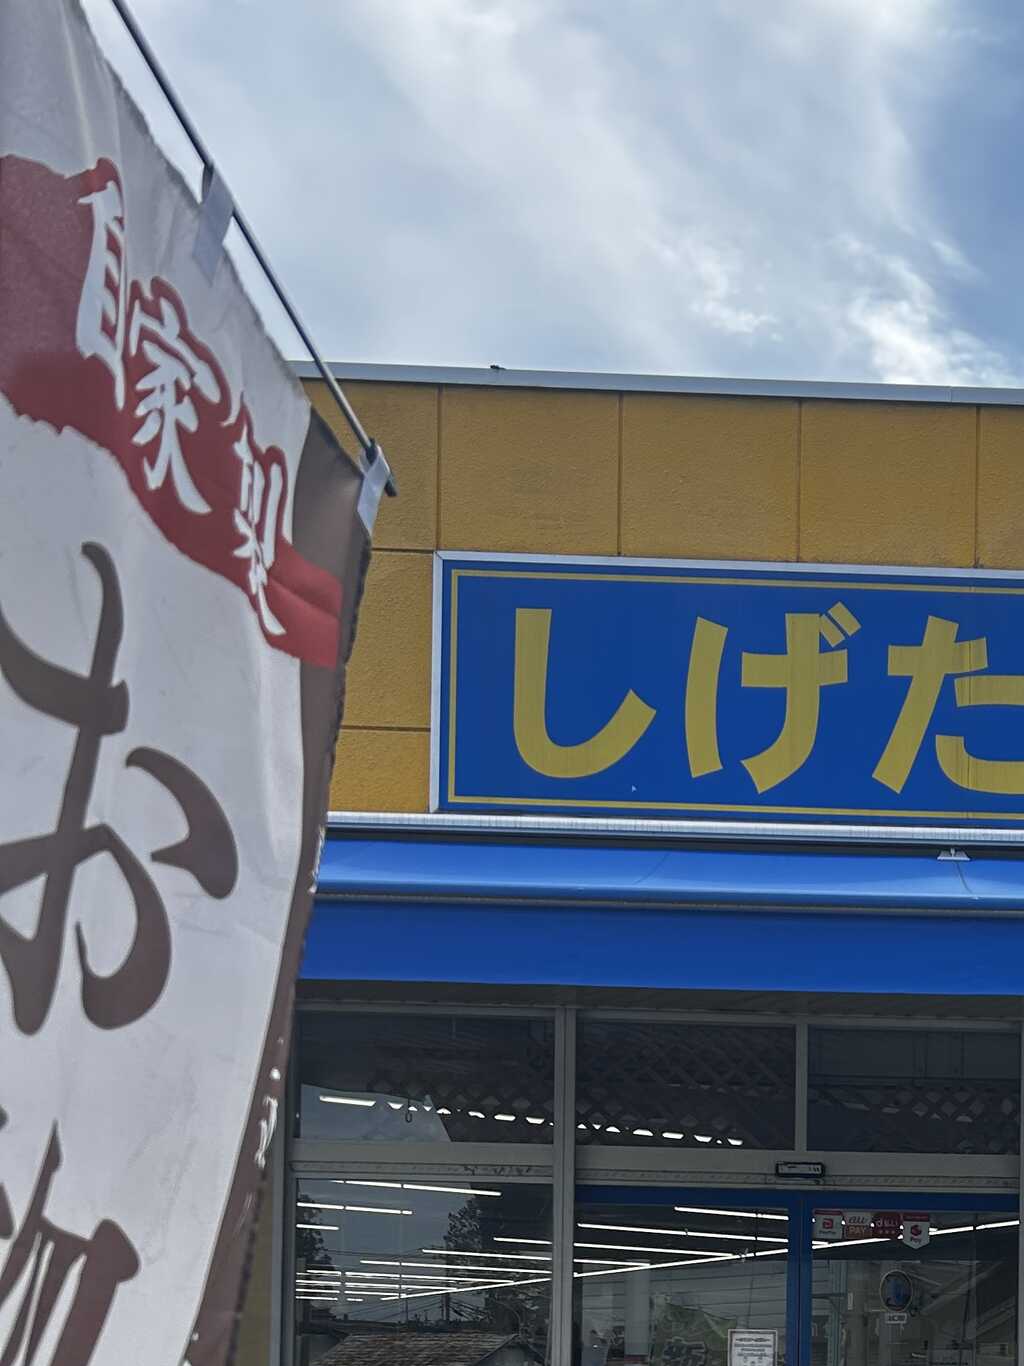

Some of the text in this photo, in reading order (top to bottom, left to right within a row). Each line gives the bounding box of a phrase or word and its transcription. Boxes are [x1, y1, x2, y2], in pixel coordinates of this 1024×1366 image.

[75, 181, 289, 637] 自家製
[848, 1226, 865, 1235] PAY
